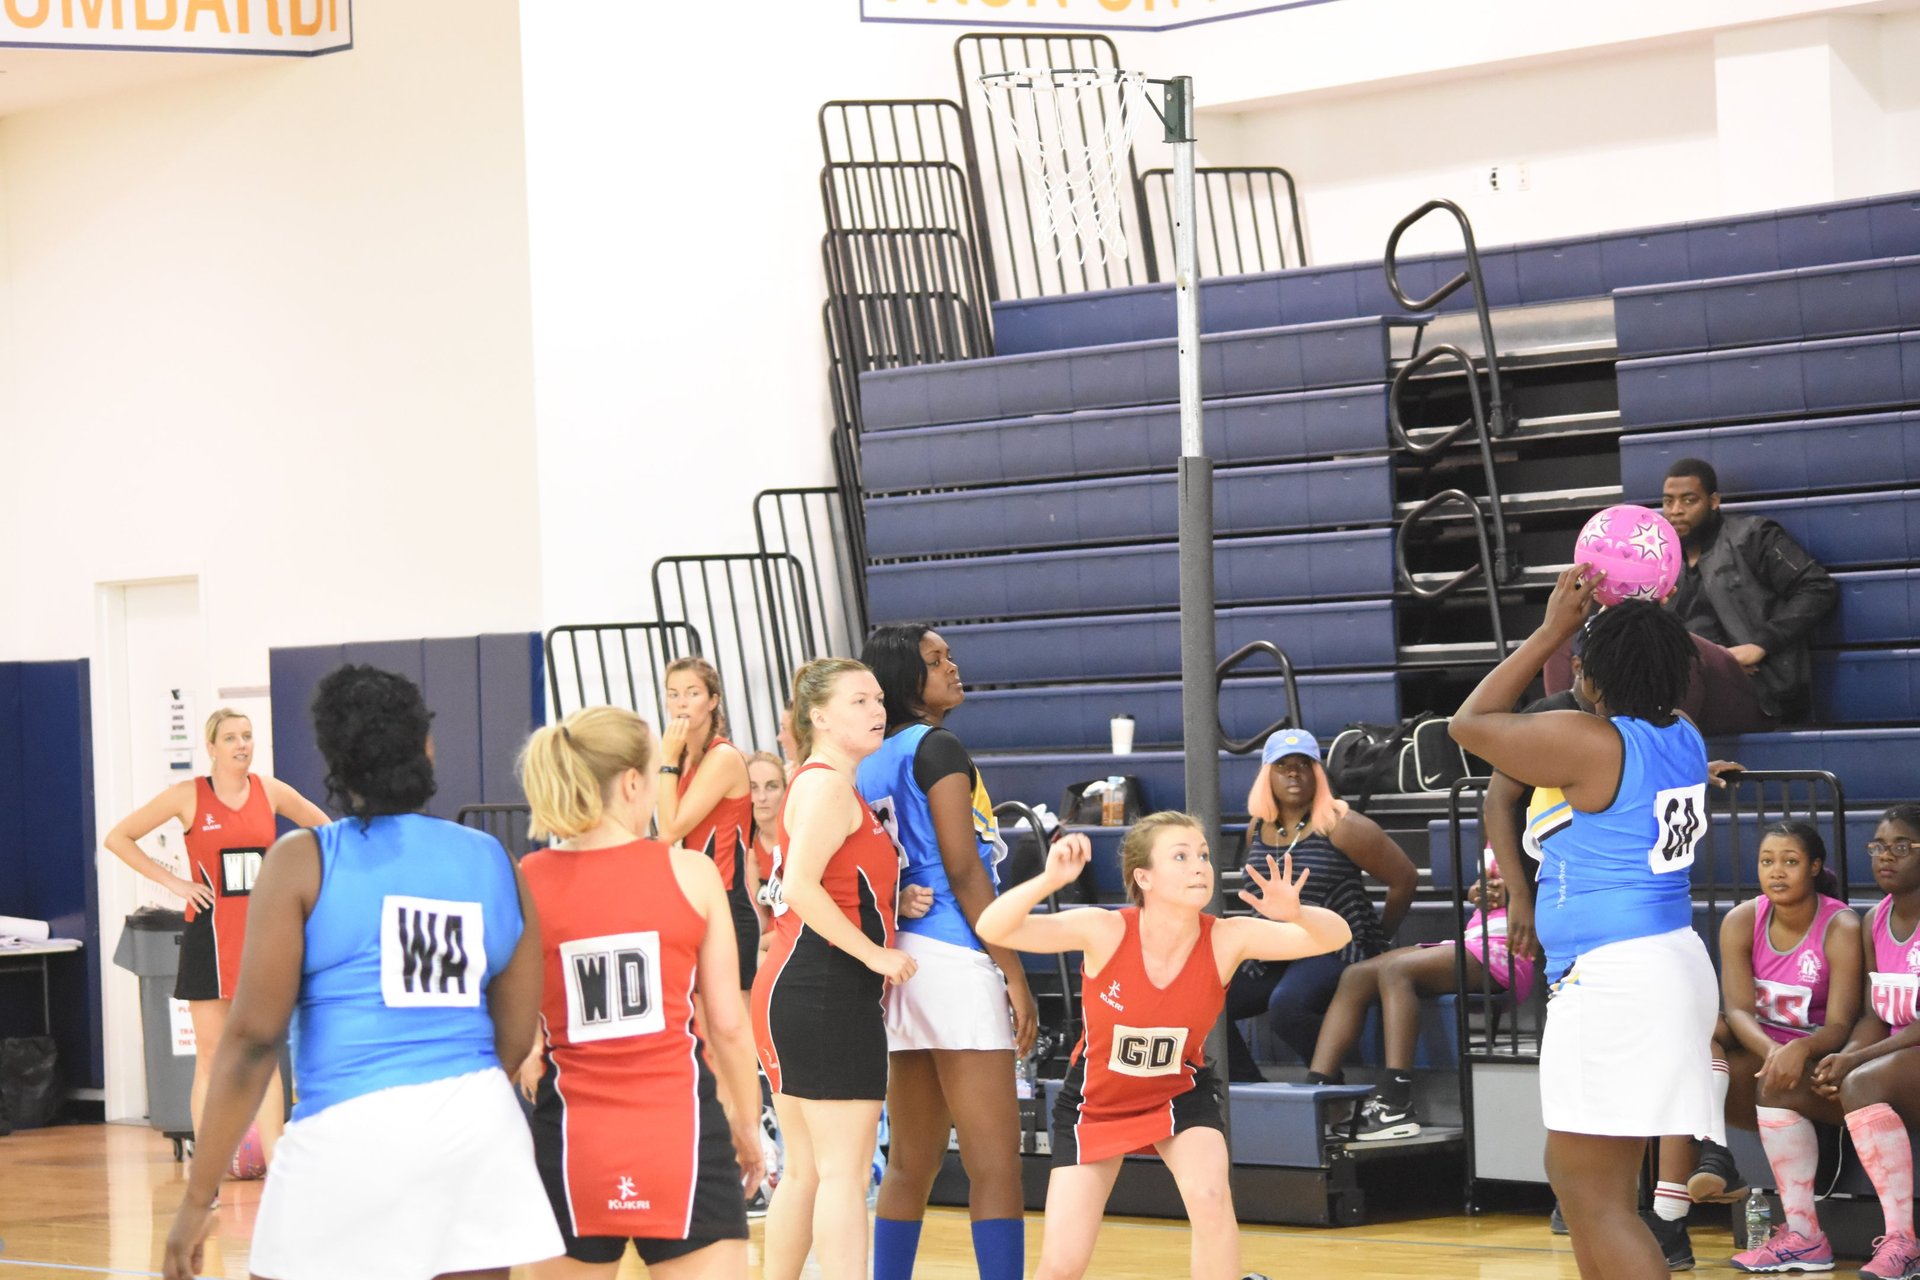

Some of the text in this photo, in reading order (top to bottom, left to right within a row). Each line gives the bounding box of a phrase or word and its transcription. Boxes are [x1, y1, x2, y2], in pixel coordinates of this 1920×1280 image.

[1661, 797, 1699, 861] GA
[223, 852, 263, 891] WD
[398, 907, 468, 994] WA
[572, 948, 652, 1025] WD
[1117, 1035, 1178, 1069] GD
[608, 1199, 651, 1210] KUKRI
